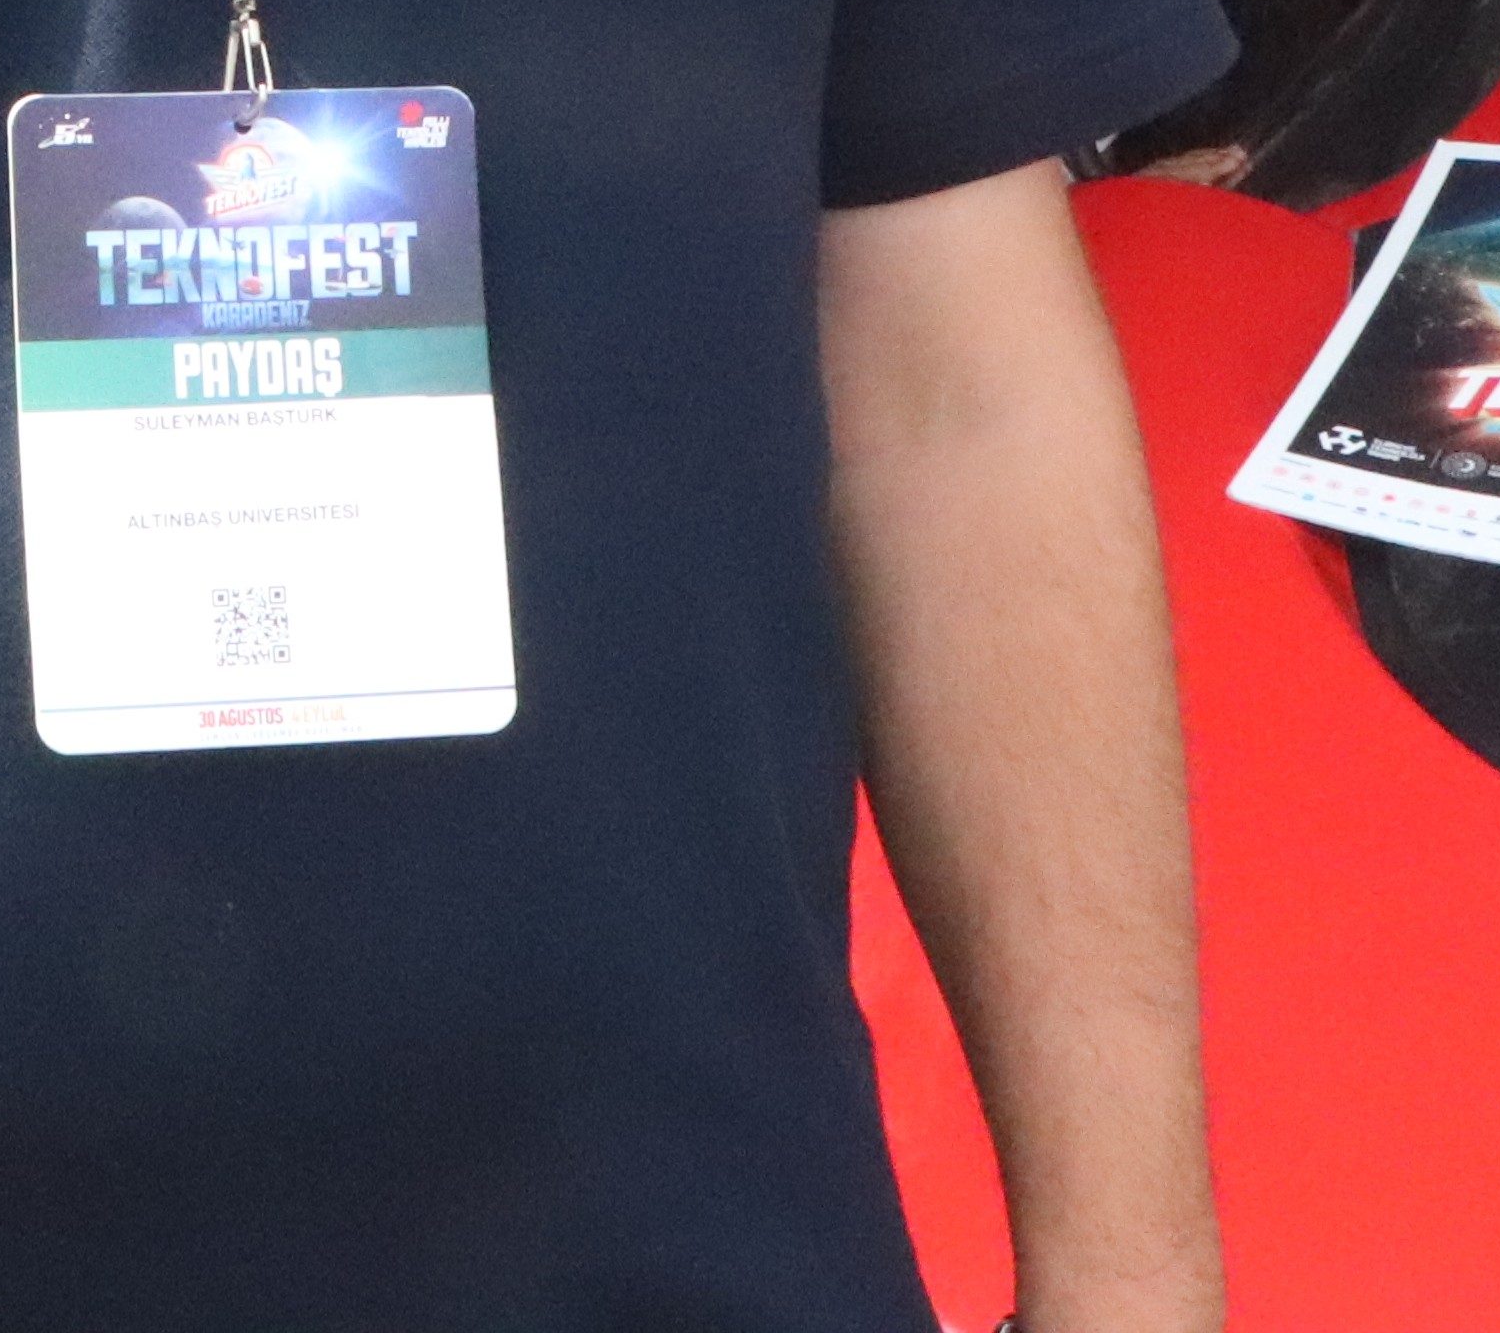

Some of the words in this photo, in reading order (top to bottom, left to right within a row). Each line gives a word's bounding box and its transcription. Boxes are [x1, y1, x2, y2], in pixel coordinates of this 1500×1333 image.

[86, 220, 419, 307] TEKNOFEST
[172, 336, 343, 401] PAYDAŞ
[199, 710, 216, 728] 30
